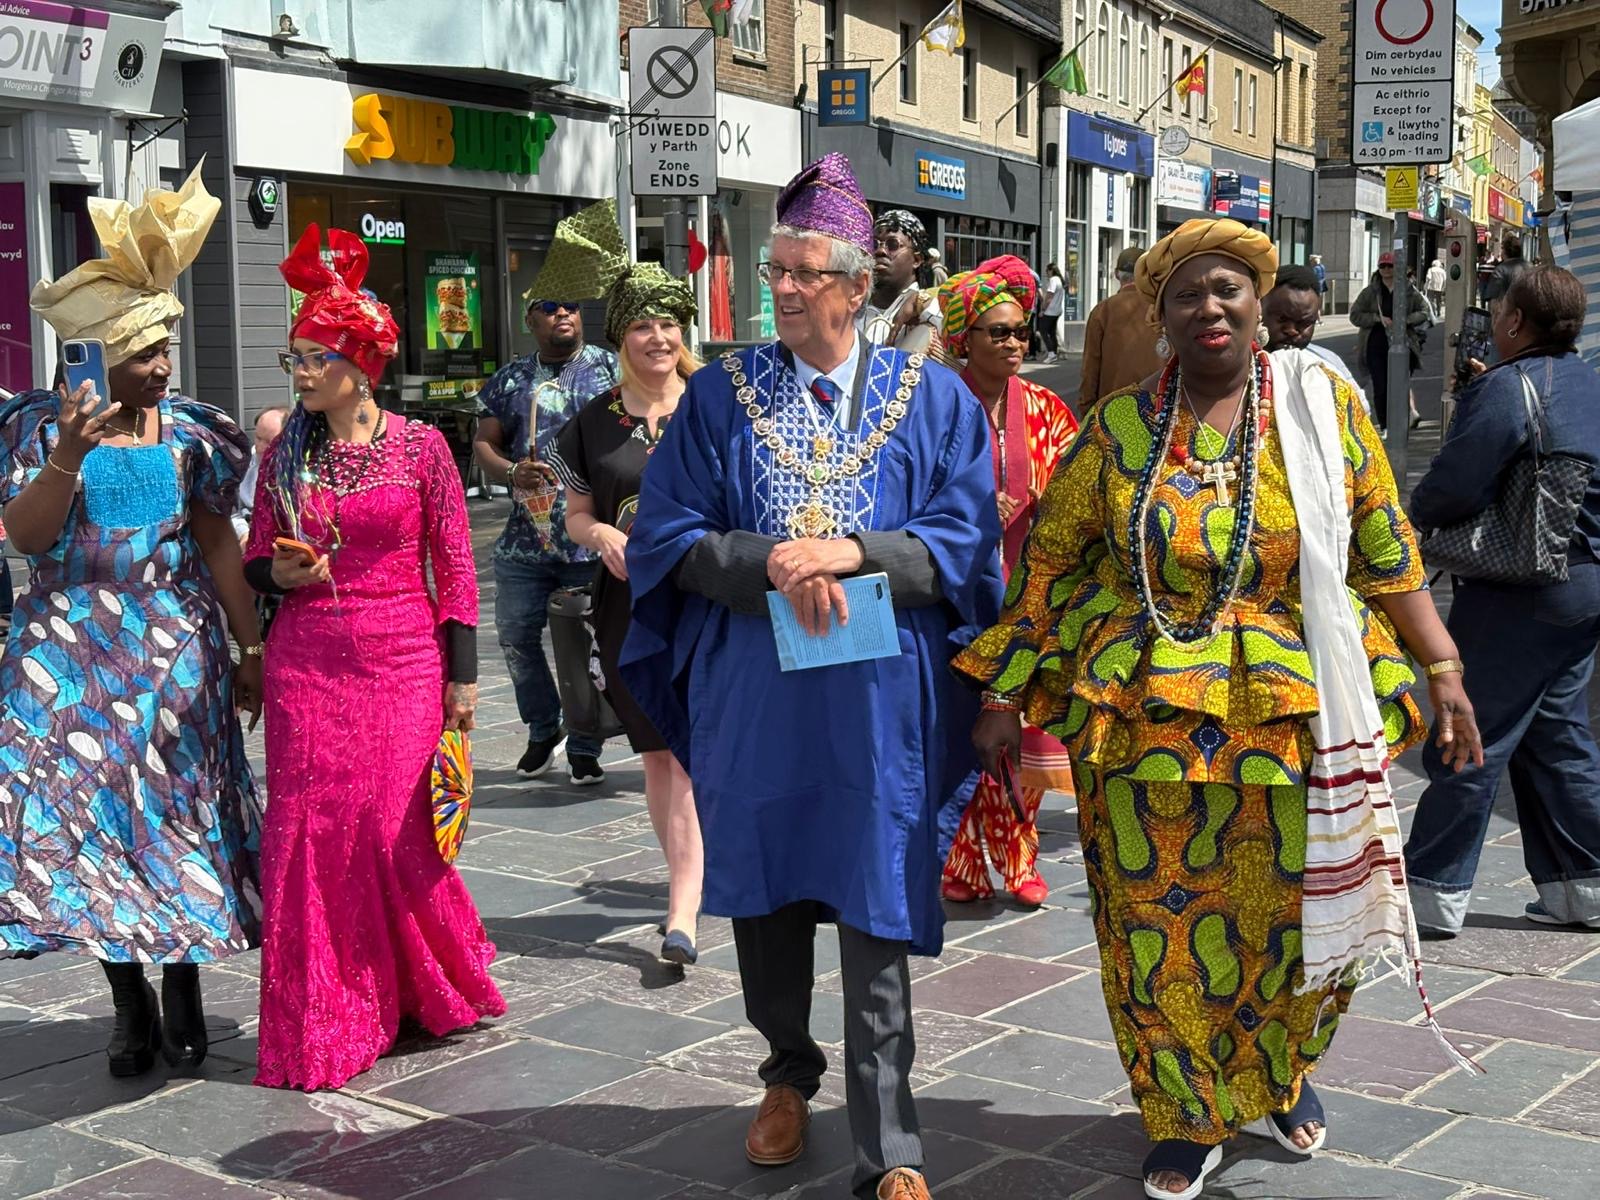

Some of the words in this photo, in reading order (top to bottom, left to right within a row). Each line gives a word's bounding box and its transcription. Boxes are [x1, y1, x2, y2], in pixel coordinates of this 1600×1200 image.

[7, 4, 30, 15] Advice
[1365, 50, 1386, 60] Dim
[1390, 49, 1442, 61] cerbydau
[1371, 66, 1387, 76] No
[1391, 65, 1436, 76] vehicles
[112, 70, 144, 88] CHARTERED
[1376, 90, 1390, 99] Ac
[1393, 88, 1430, 99] eithrio
[831, 108, 856, 116] GREGGS
[1373, 106, 1411, 116] Except
[1415, 104, 1431, 114] for
[638, 123, 710, 136] DIWEDD
[1398, 119, 1440, 130] llwytho
[343, 93, 558, 176] SUBWAY
[1387, 126, 1395, 136] &
[1398, 130, 1439, 142] loading
[650, 143, 657, 153] y
[662, 140, 698, 152] Parth
[1359, 147, 1387, 158] 4.30
[1389, 148, 1406, 159] pm
[1415, 146, 1424, 155] 11
[1426, 147, 1443, 156] am
[658, 160, 690, 171] Zone
[650, 174, 700, 187] ENDS
[929, 161, 966, 191] GREGGS
[361, 213, 405, 242] Open
[429, 266, 449, 274] SPICED
[450, 266, 476, 275] CHICKEN
